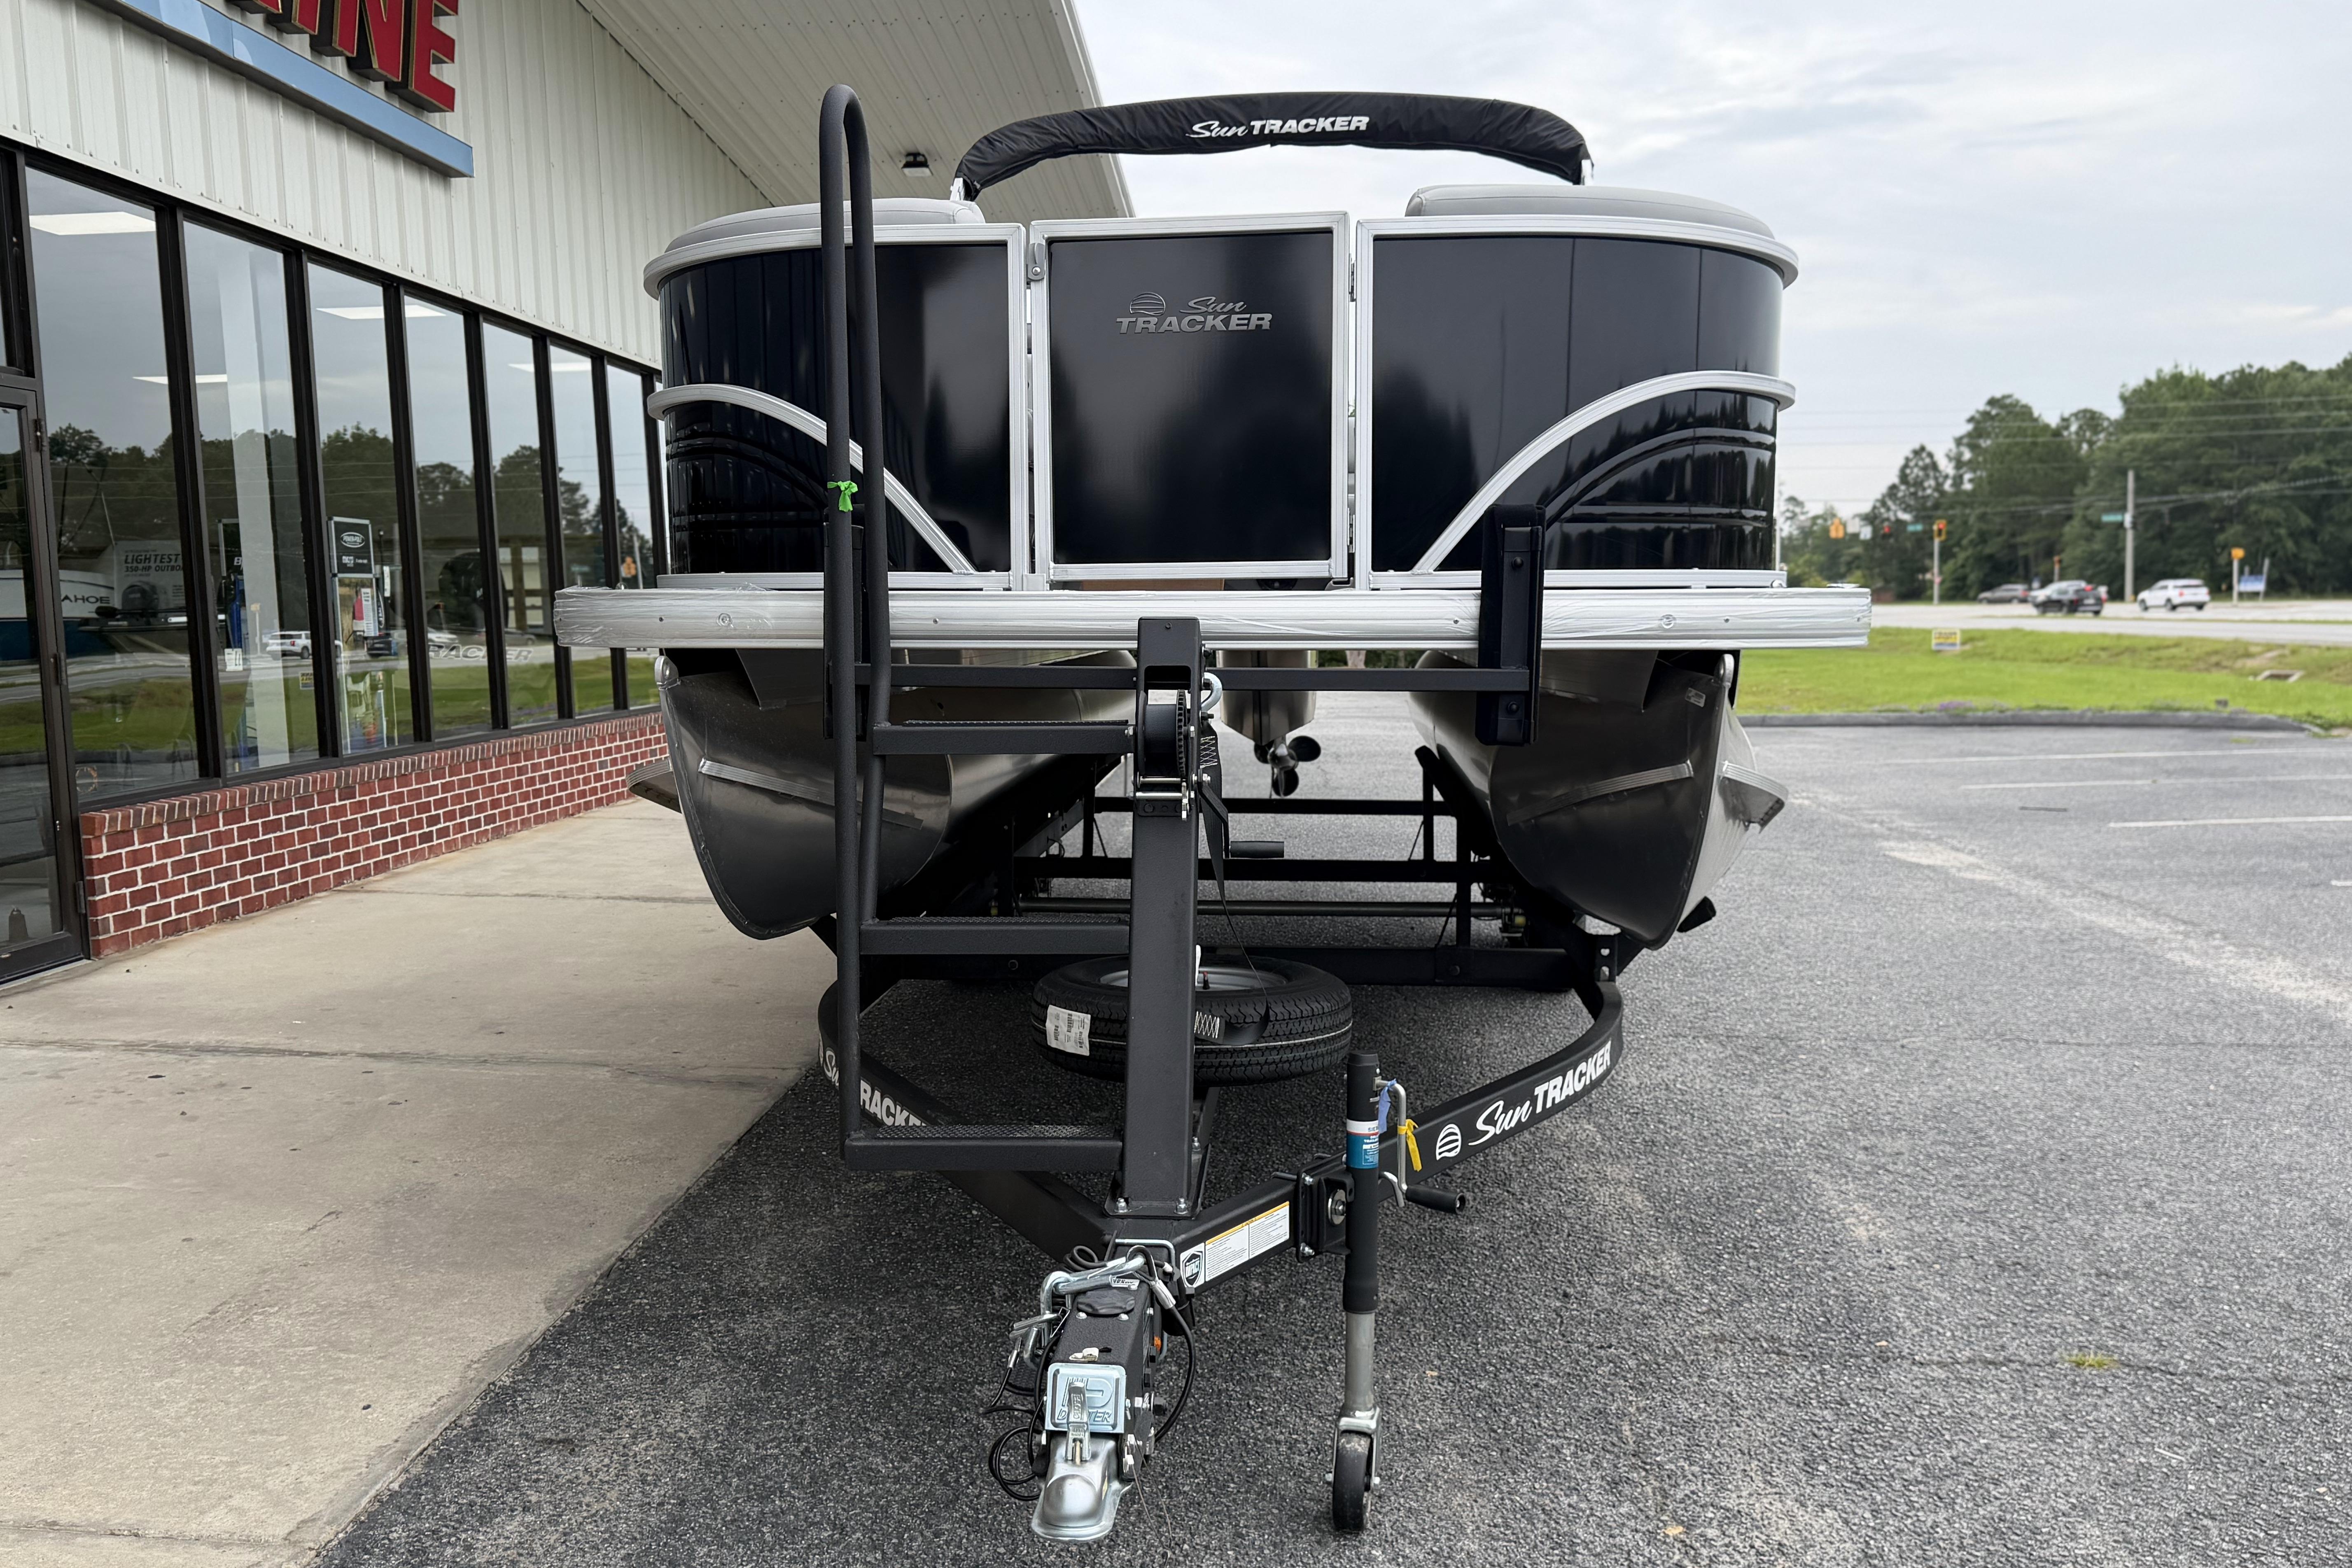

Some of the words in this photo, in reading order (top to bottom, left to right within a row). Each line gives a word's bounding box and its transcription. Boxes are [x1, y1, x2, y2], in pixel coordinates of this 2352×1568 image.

[1185, 121, 1248, 138] Sun
[1250, 116, 1370, 135] TRACKER
[1179, 296, 1247, 314] Sun
[1116, 313, 1273, 334] TRACKER
[124, 553, 181, 564] LIGHTEST
[61, 594, 110, 604] AHOE
[824, 1050, 839, 1086] Su
[1468, 1100, 1532, 1146] Sun
[1534, 1040, 1612, 1113] TRACKER
